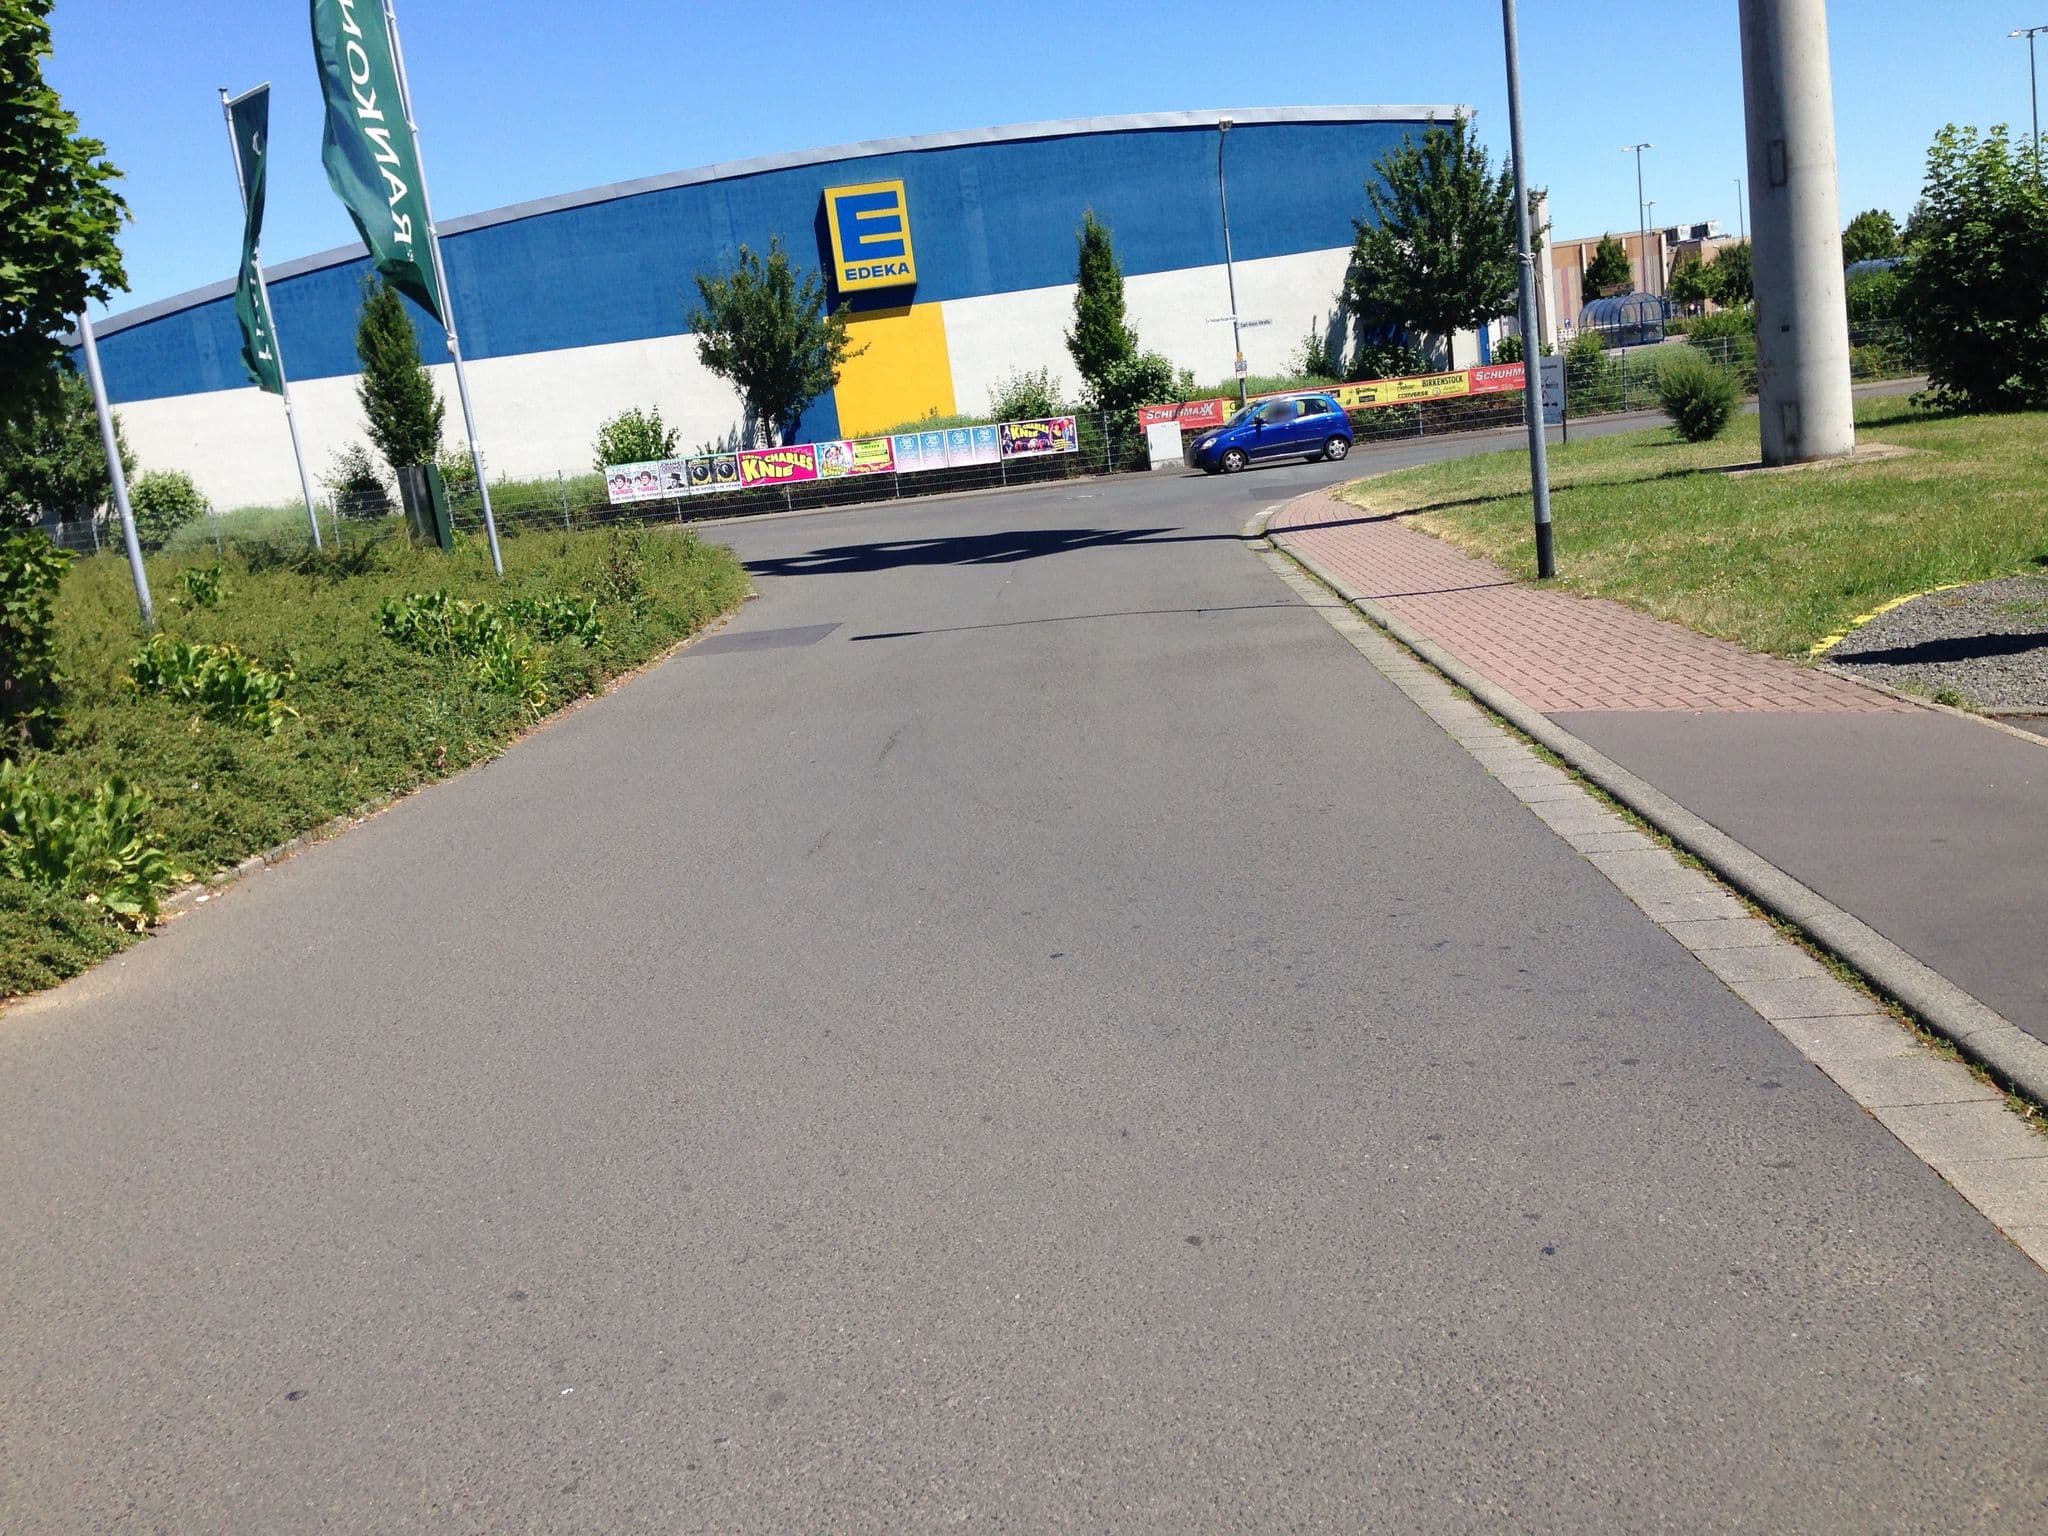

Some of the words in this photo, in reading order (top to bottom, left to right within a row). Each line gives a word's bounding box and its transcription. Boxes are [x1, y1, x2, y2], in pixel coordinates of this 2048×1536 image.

[835, 191, 905, 262] E
[845, 262, 911, 281] EDEKA
[1422, 374, 1464, 388] BIRKENSTOCK
[742, 459, 795, 483] KNIE
[764, 452, 814, 471] CHARLES
